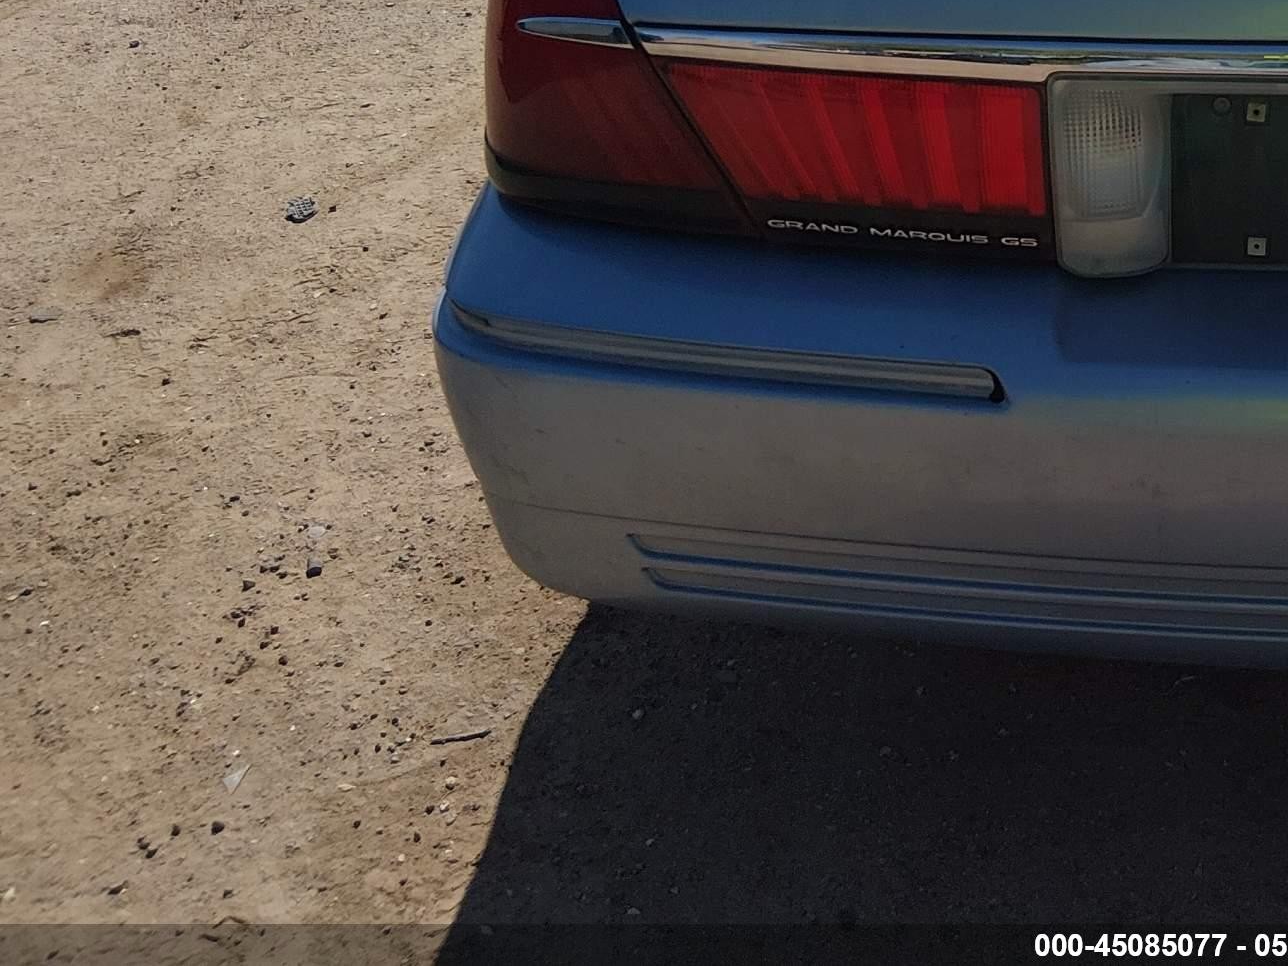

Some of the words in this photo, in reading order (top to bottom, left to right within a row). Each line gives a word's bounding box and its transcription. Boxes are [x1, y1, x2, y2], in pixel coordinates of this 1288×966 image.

[767, 218, 859, 235] GRAND
[869, 227, 989, 244] MARQUIS
[1001, 236, 1039, 247] GS
